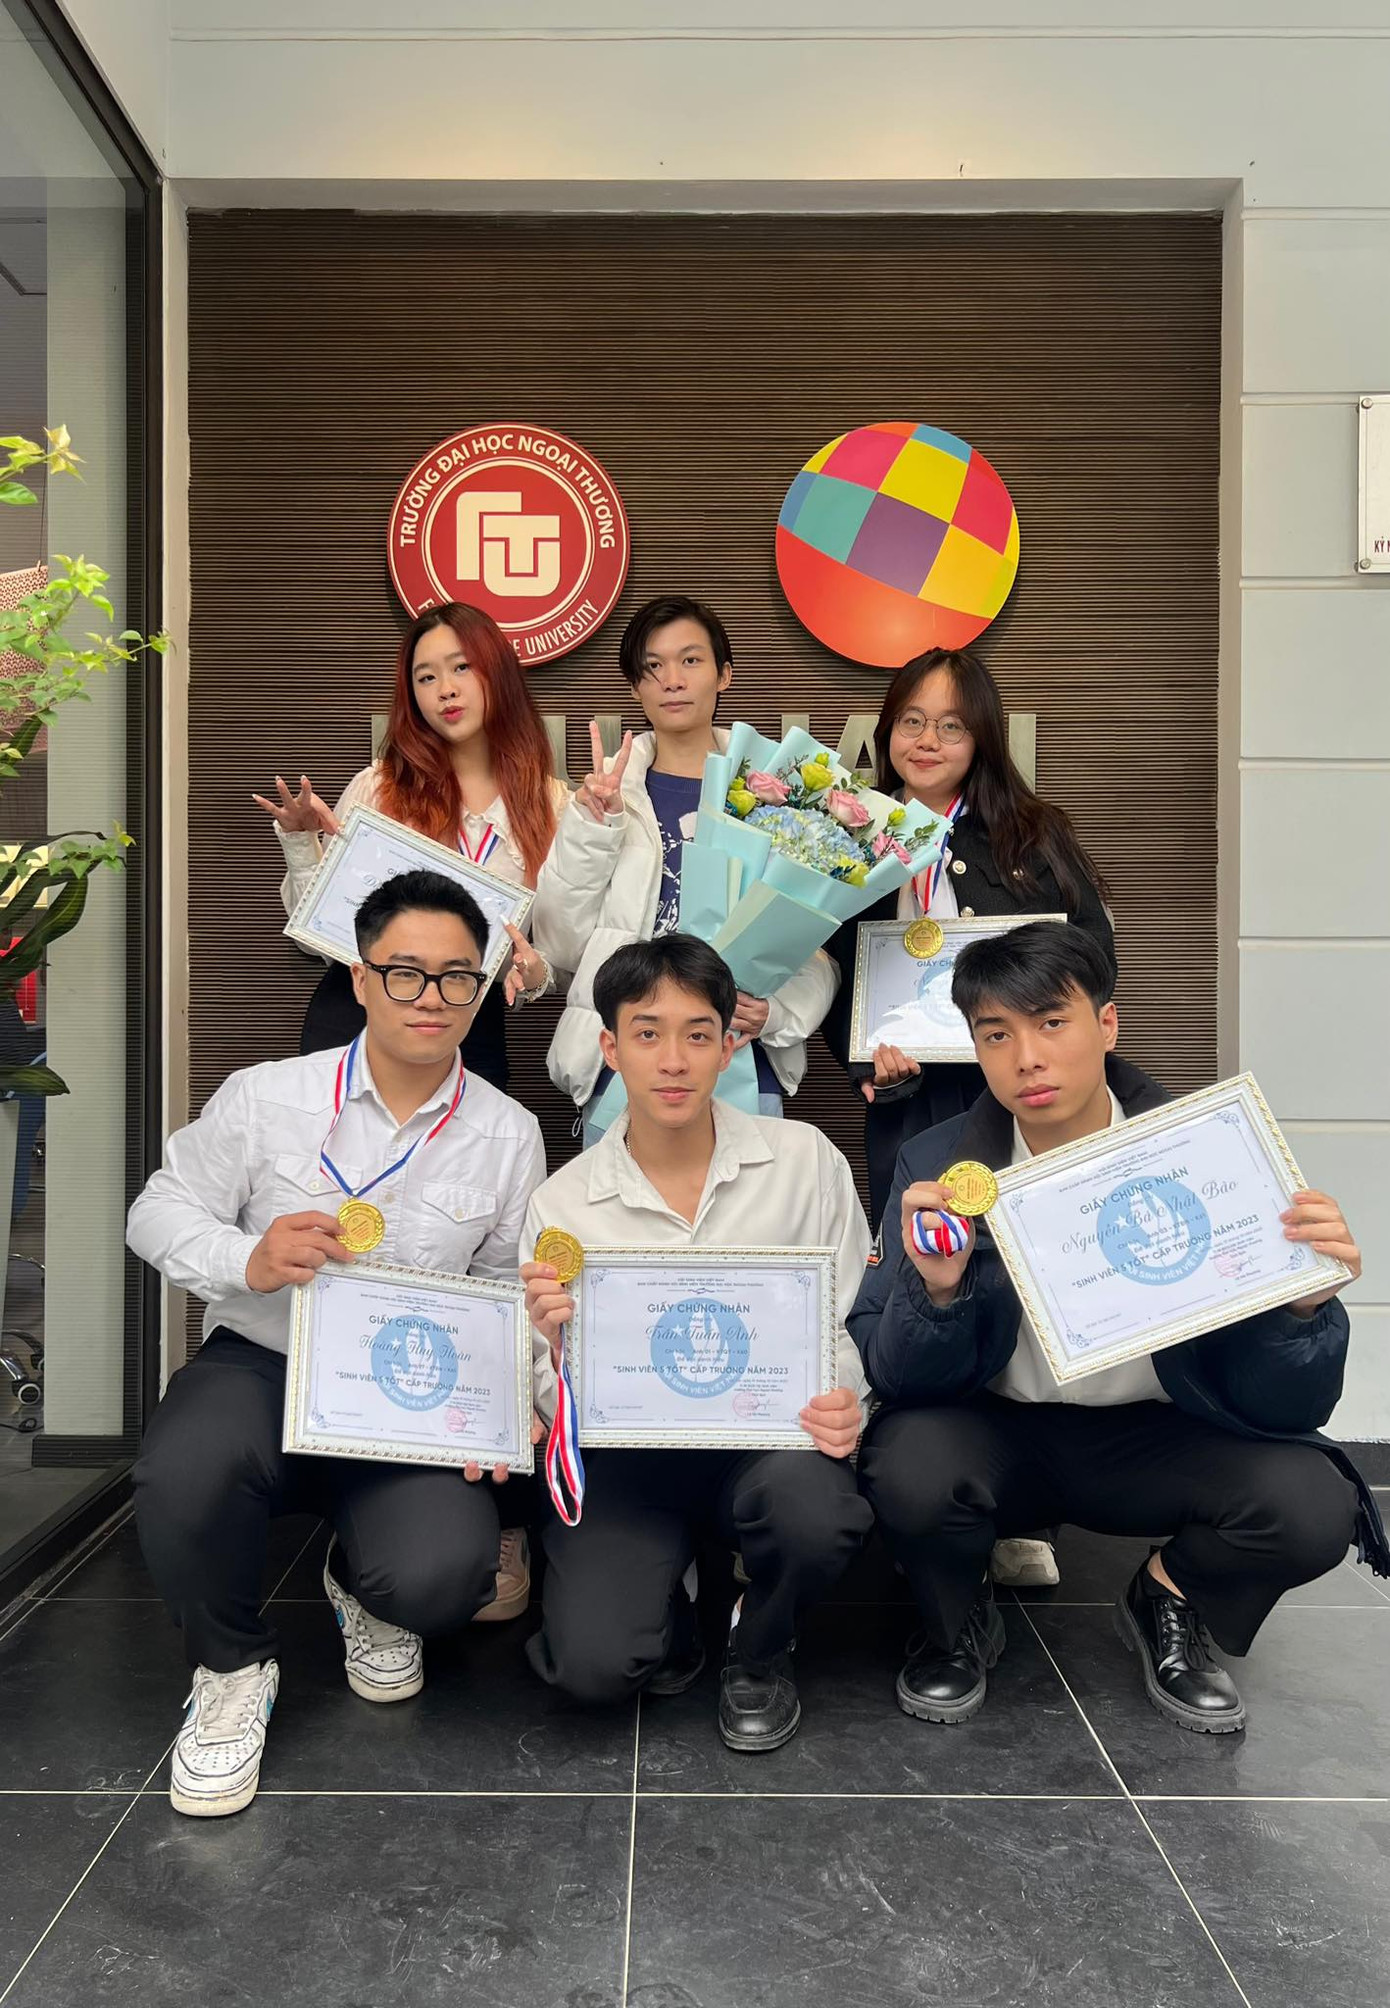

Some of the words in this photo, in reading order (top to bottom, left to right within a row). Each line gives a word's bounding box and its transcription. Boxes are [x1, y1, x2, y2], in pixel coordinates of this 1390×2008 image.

[400, 468, 440, 547] TRƯỜNG
[437, 444, 471, 472] ĐẠI
[472, 434, 514, 455] HỌC
[518, 435, 578, 472] NGOẠI
[574, 466, 615, 549] THƯƠNG
[456, 491, 560, 597] FTU
[526, 599, 599, 656] UNIVERSITY
[1080, 1197, 1107, 1215] GIẤY
[1111, 1181, 1153, 1203] CHỨNG
[1155, 1166, 1189, 1185] NHẬN
[1236, 1214, 1260, 1228] 2023
[647, 1301, 674, 1313] GIẤY
[677, 1301, 717, 1313] CHỨNG
[720, 1302, 750, 1316] NHẬN
[369, 1313, 393, 1326] GIẤY
[395, 1318, 430, 1331] CHỨNG
[433, 1322, 459, 1335] NHẬN
[768, 1367, 789, 1375] 2023
[474, 1388, 491, 1396] 2023
